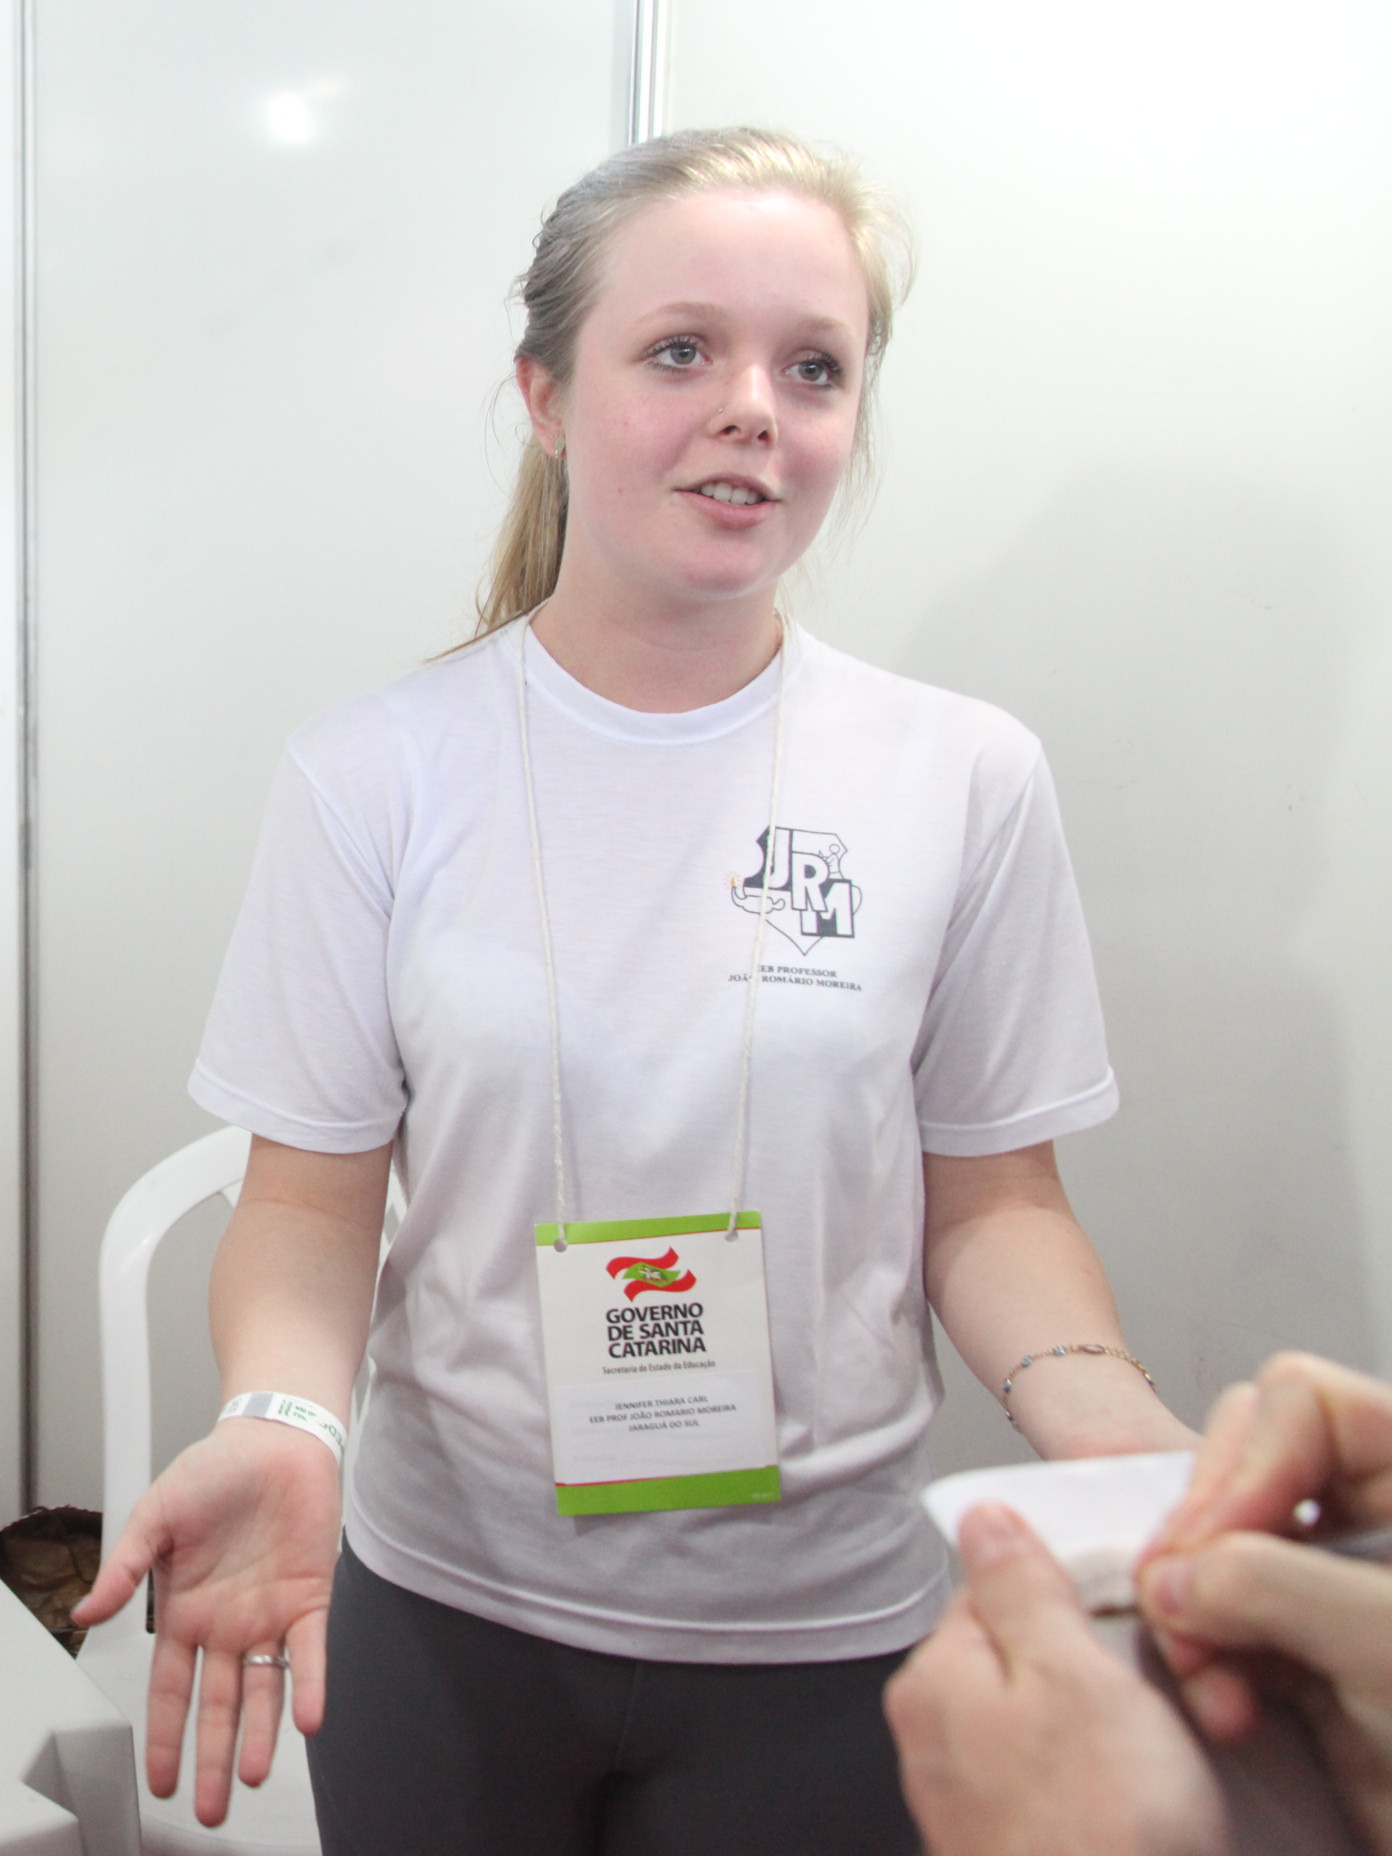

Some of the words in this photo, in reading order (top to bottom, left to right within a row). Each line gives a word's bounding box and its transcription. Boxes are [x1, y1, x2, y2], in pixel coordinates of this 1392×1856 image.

[777, 965, 837, 978] PROFESSOR
[728, 973, 753, 982] JOÃ
[761, 975, 814, 986] ROMÁRIO
[815, 979, 862, 992] MOREIRA
[606, 1302, 704, 1324] GOVERNO
[608, 1325, 634, 1341] DE
[639, 1319, 704, 1340] SANTA
[608, 1337, 707, 1358] CATARINA
[602, 1364, 638, 1375] Secretaria
[639, 1363, 647, 1373] de
[648, 1362, 672, 1372] Estado
[673, 1361, 682, 1370] da
[683, 1358, 716, 1370] Educação
[606, 1412, 628, 1422] PROF
[629, 1409, 652, 1421] JOÃO
[696, 1402, 736, 1415] MOREIRA
[615, 1400, 654, 1411] JENNIFER
[655, 1397, 686, 1408] THIARA
[687, 1394, 709, 1404] CARL
[669, 1419, 683, 1429] DO
[684, 1417, 700, 1427] SUL
